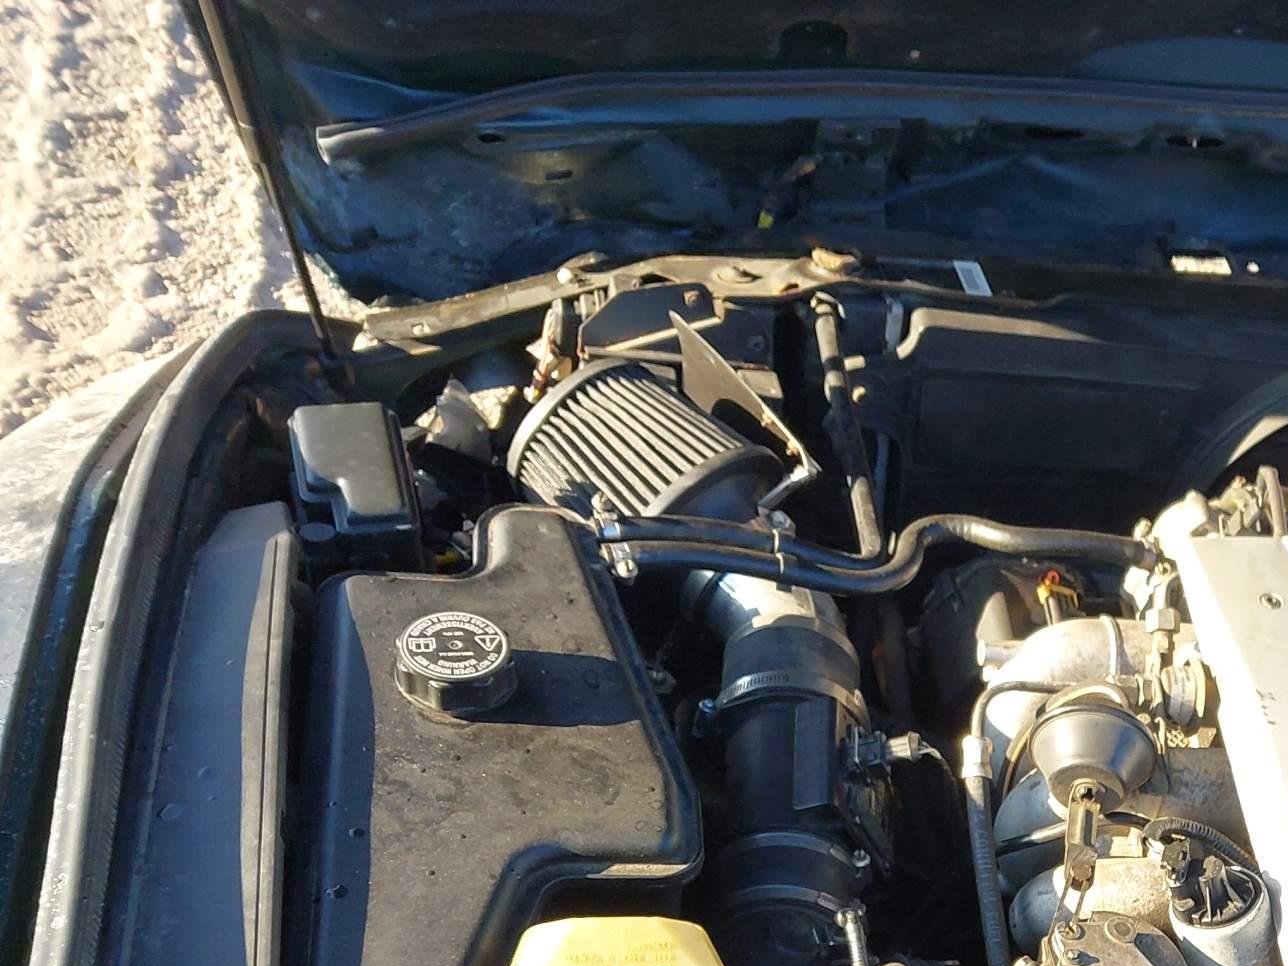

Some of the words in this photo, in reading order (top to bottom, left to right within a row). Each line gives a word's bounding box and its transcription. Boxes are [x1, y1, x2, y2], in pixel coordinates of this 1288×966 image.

[487, 652, 498, 662] DO
[437, 658, 478, 668] WARNING
[475, 660, 491, 671] NOT
[453, 667, 476, 675] OPEN
